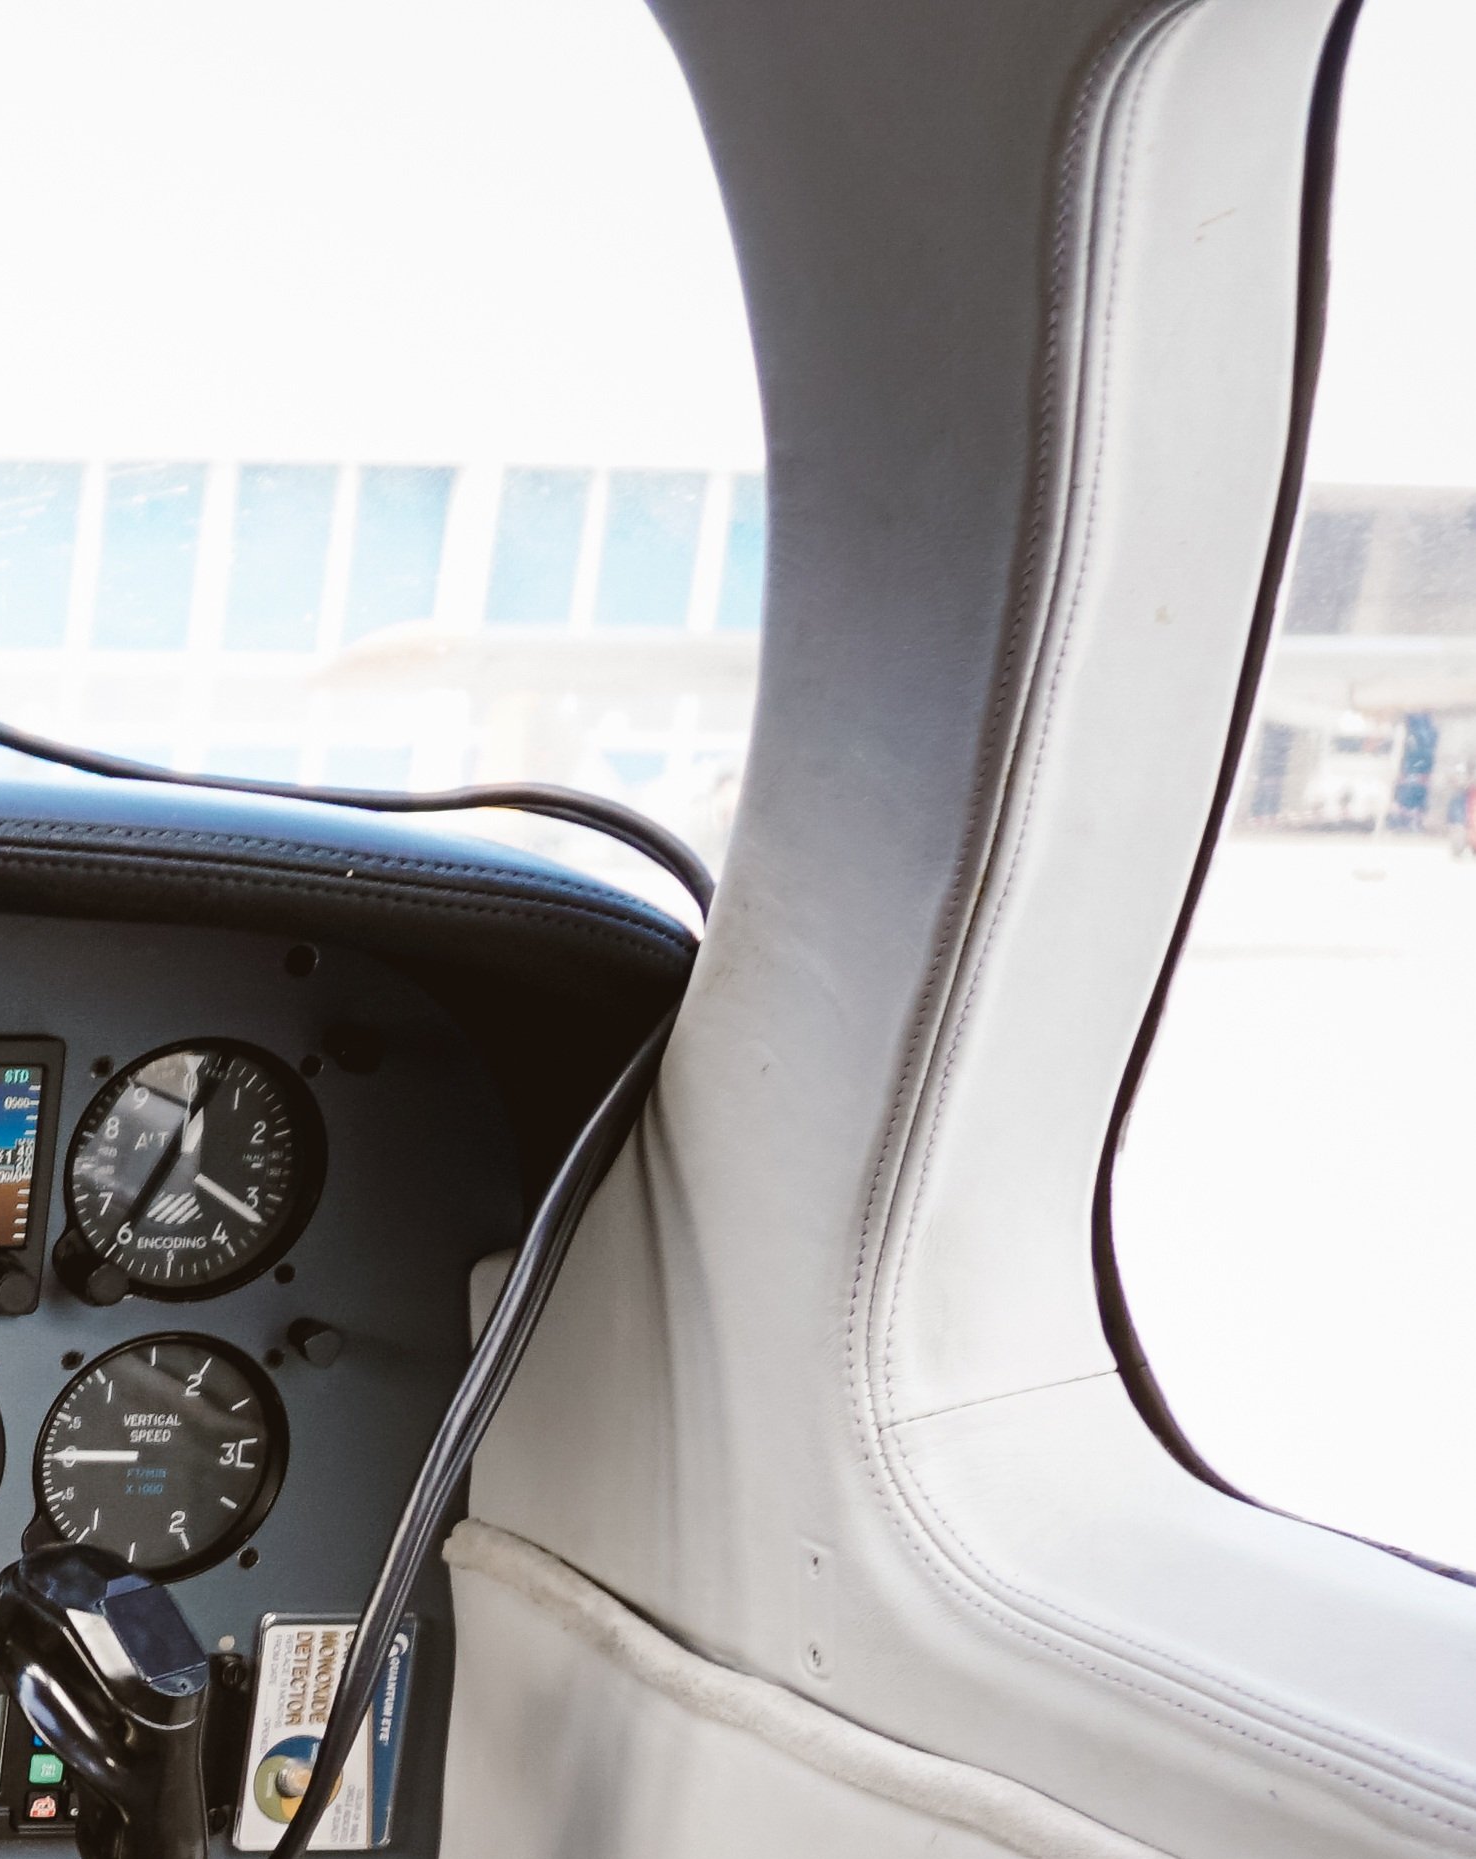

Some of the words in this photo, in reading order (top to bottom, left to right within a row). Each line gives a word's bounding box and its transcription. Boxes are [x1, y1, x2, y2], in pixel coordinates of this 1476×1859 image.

[4, 1069, 30, 1083] STD
[105, 1116, 120, 1139] 8
[251, 1121, 266, 1143] 2
[137, 1234, 206, 1250] ENCODING
[124, 1413, 181, 1427] VERTICAL
[130, 1430, 171, 1443] SPEED
[285, 1631, 315, 1726] DETECTOR
[309, 1632, 340, 1724] MONOXIDE
